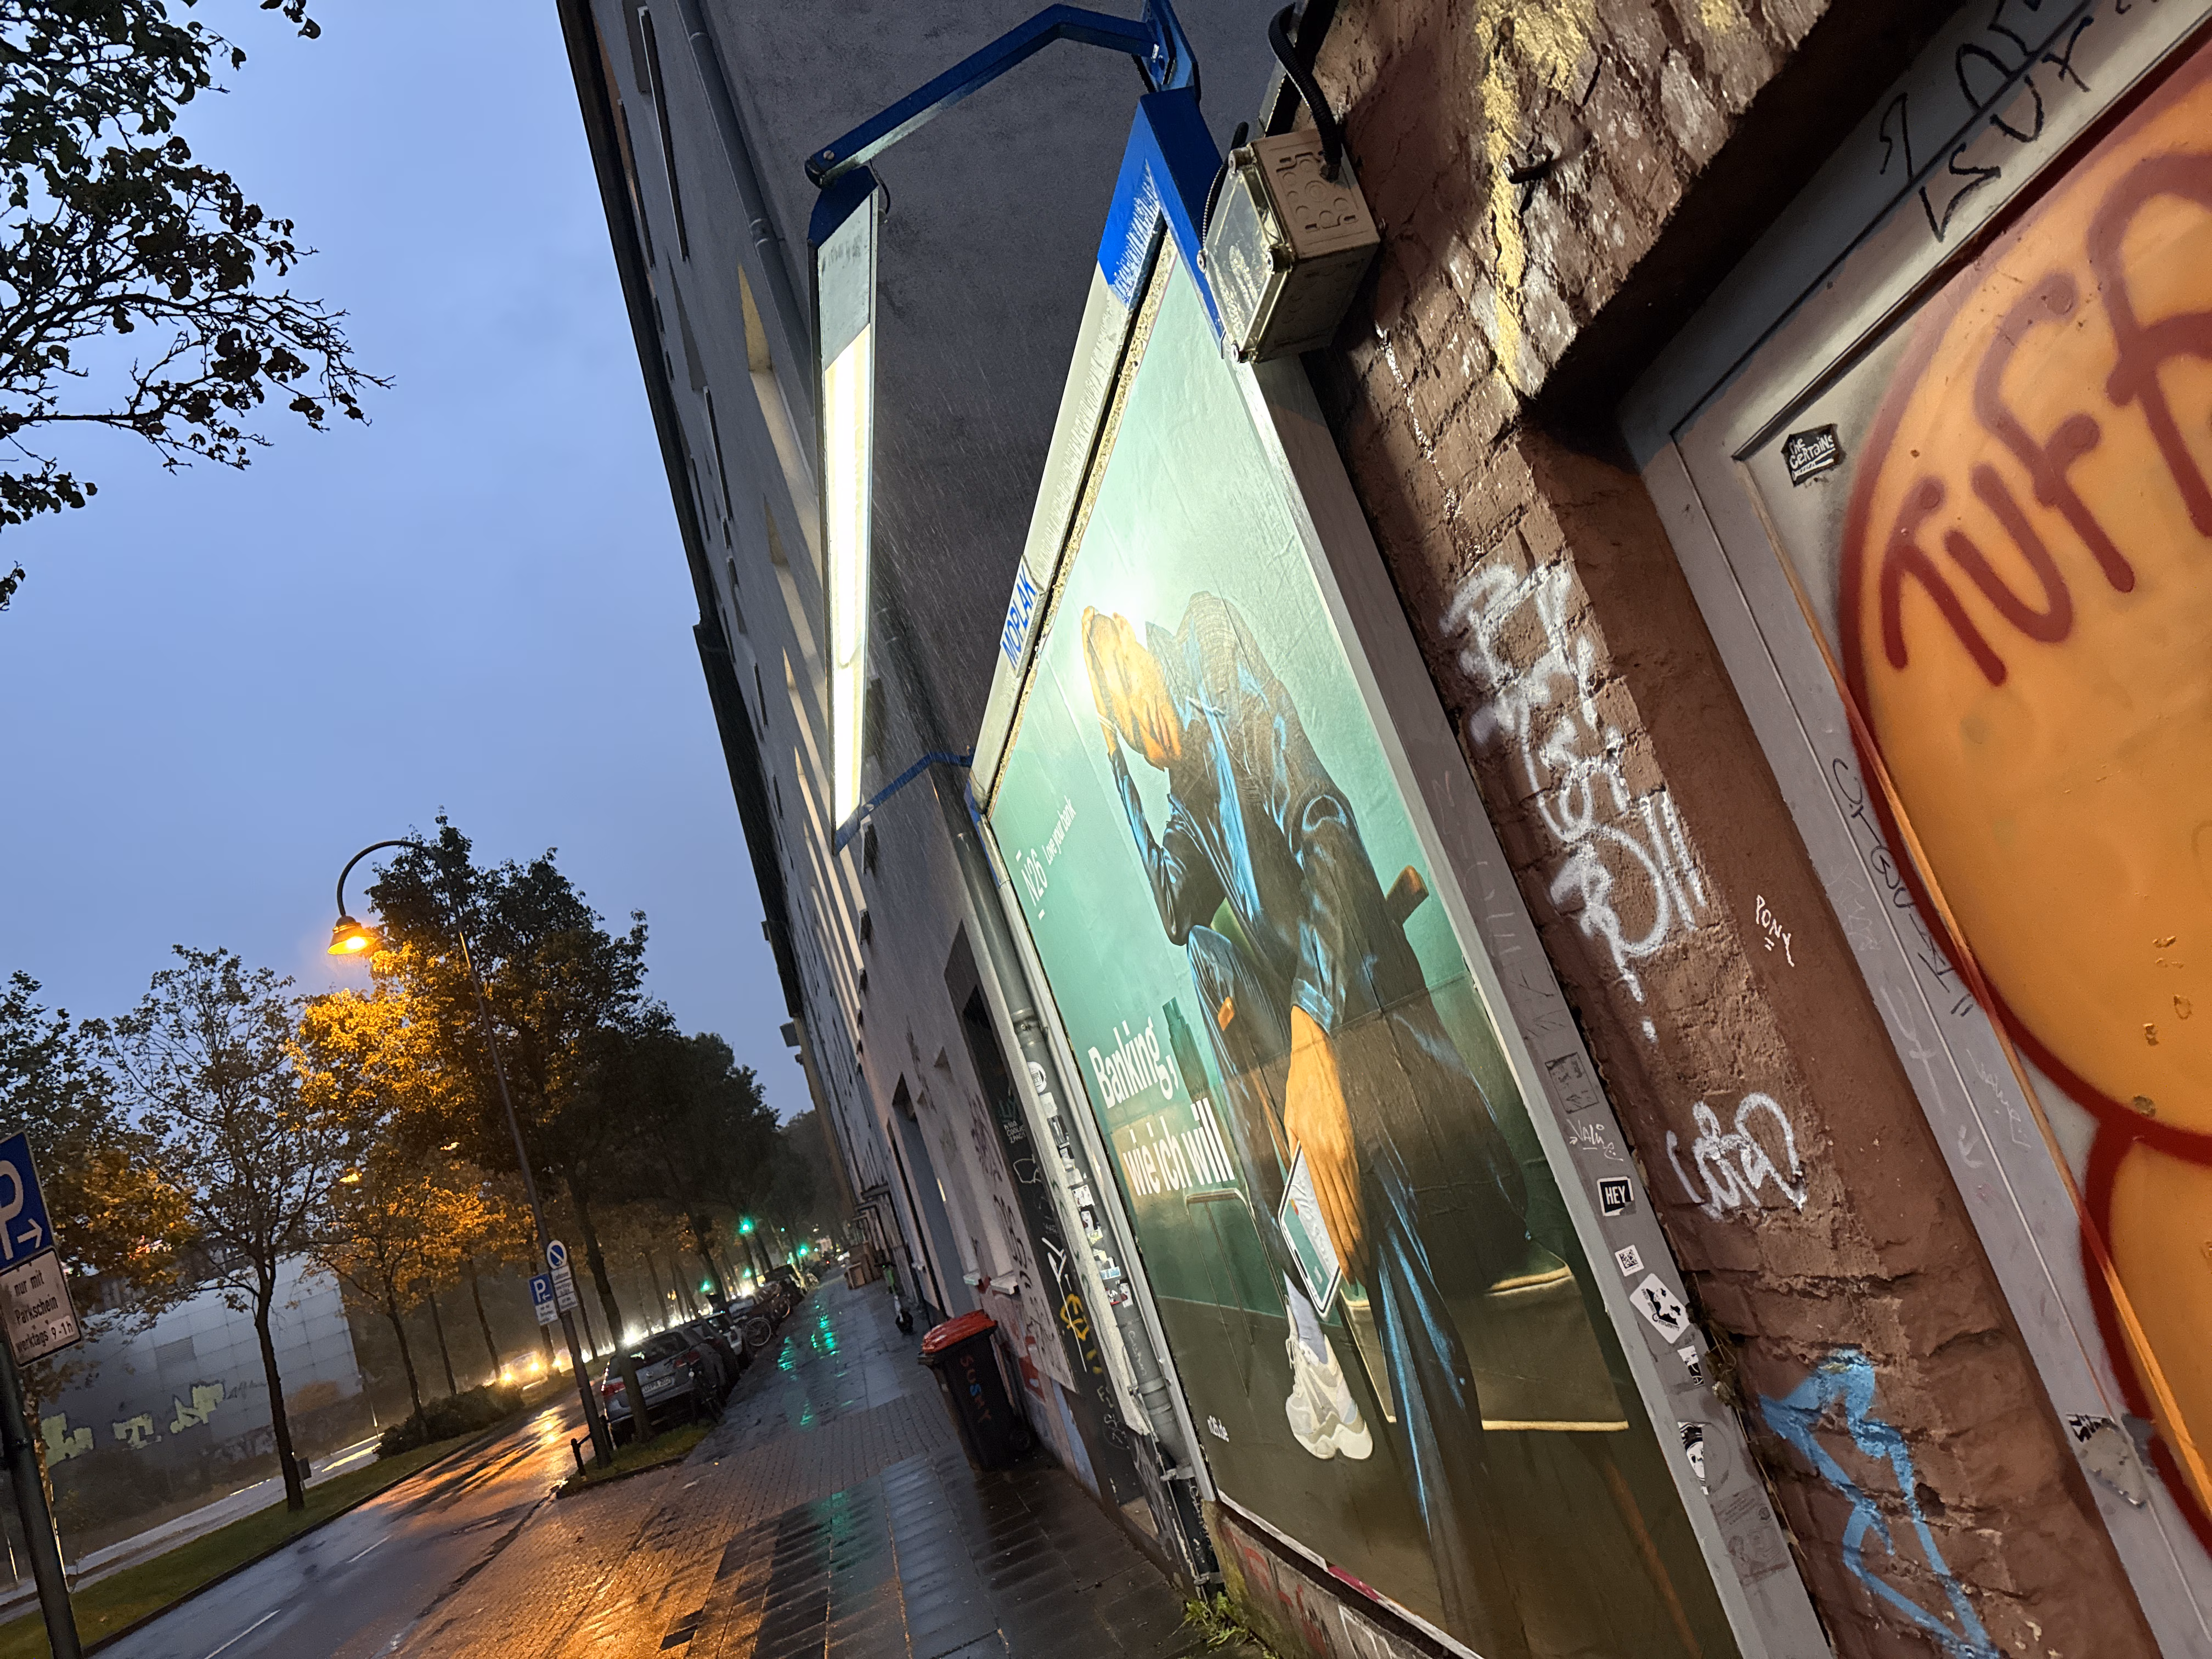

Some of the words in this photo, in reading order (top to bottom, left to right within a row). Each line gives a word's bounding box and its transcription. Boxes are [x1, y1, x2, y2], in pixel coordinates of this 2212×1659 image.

[1002, 563, 1036, 672] MOPLAK
[1057, 794, 1076, 832] bank
[1041, 844, 1057, 865] Love
[1052, 819, 1065, 855] your
[1021, 848, 1047, 907] N26
[1756, 894, 1795, 967] PONY
[1088, 1016, 1179, 1109] Banking,
[1122, 1129, 1161, 1196] wie
[1146, 1116, 1193, 1191] ich
[1181, 1097, 1235, 1186] will
[1605, 1186, 1626, 1205] HEY
[14, 1280, 28, 1297] nur
[30, 1269, 45, 1290] mit
[534, 1279, 546, 1303] P
[15, 1293, 59, 1325] Parkschein
[15, 1329, 49, 1354] werktags
